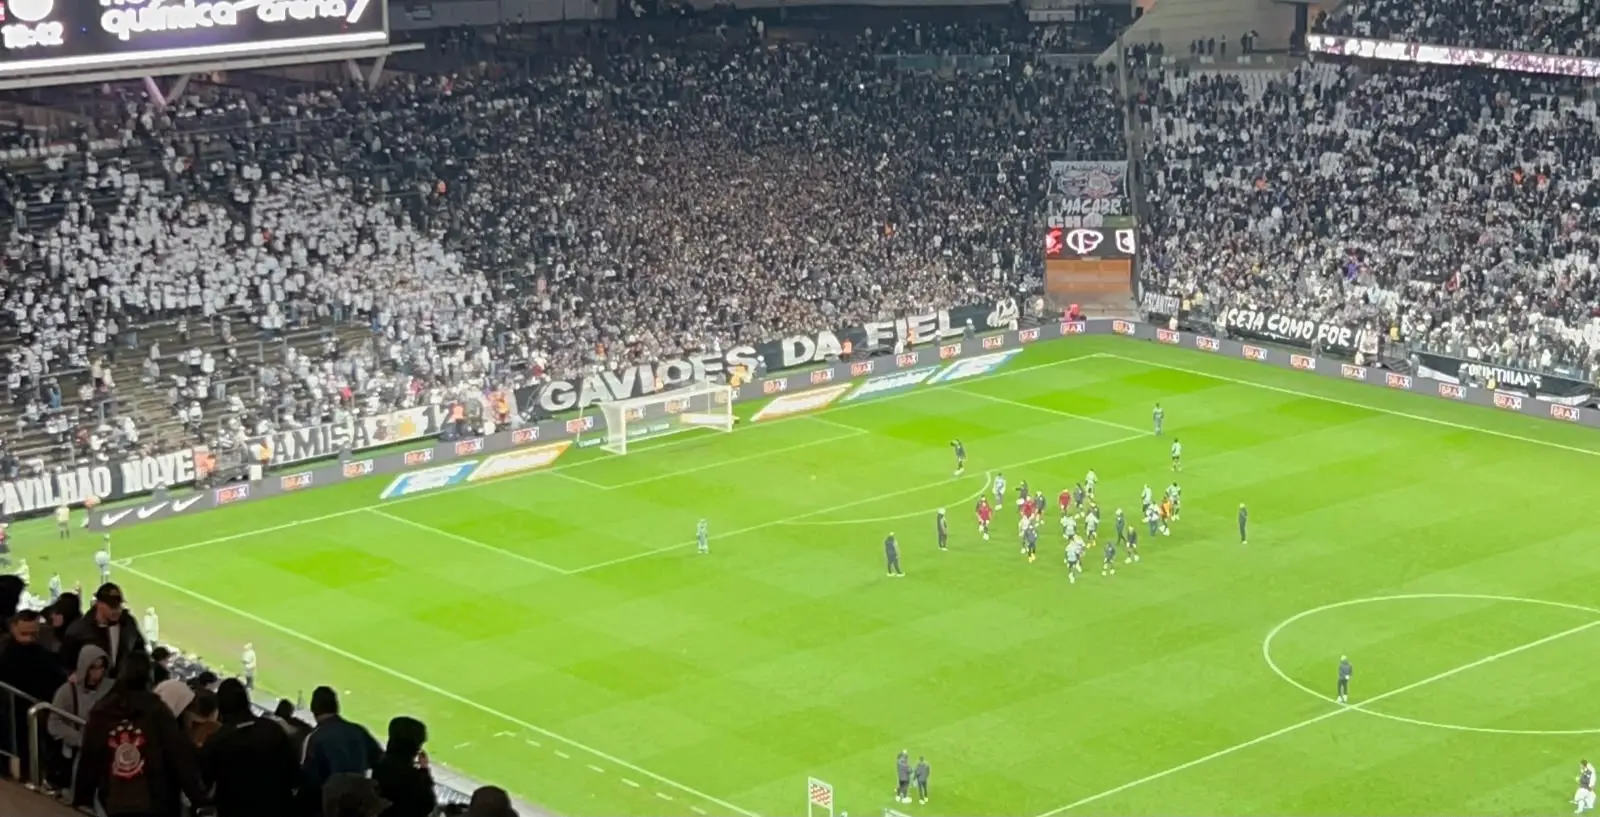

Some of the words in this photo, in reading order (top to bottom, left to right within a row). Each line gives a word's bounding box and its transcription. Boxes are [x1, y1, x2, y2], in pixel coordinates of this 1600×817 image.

[1227, 308, 1265, 331] SEJA
[1267, 313, 1315, 340] COMO
[1318, 324, 1351, 347] FOR
[781, 330, 842, 366] DA
[864, 310, 965, 346] FIEL
[1342, 365, 1366, 379] BRAX
[1387, 373, 1411, 387] BRAX
[1439, 384, 1465, 398] BRAX
[1495, 393, 1521, 408] BRAX
[1552, 405, 1579, 420] BRAX
[268, 419, 370, 465] AMISA
[120, 449, 195, 494] NOVE
